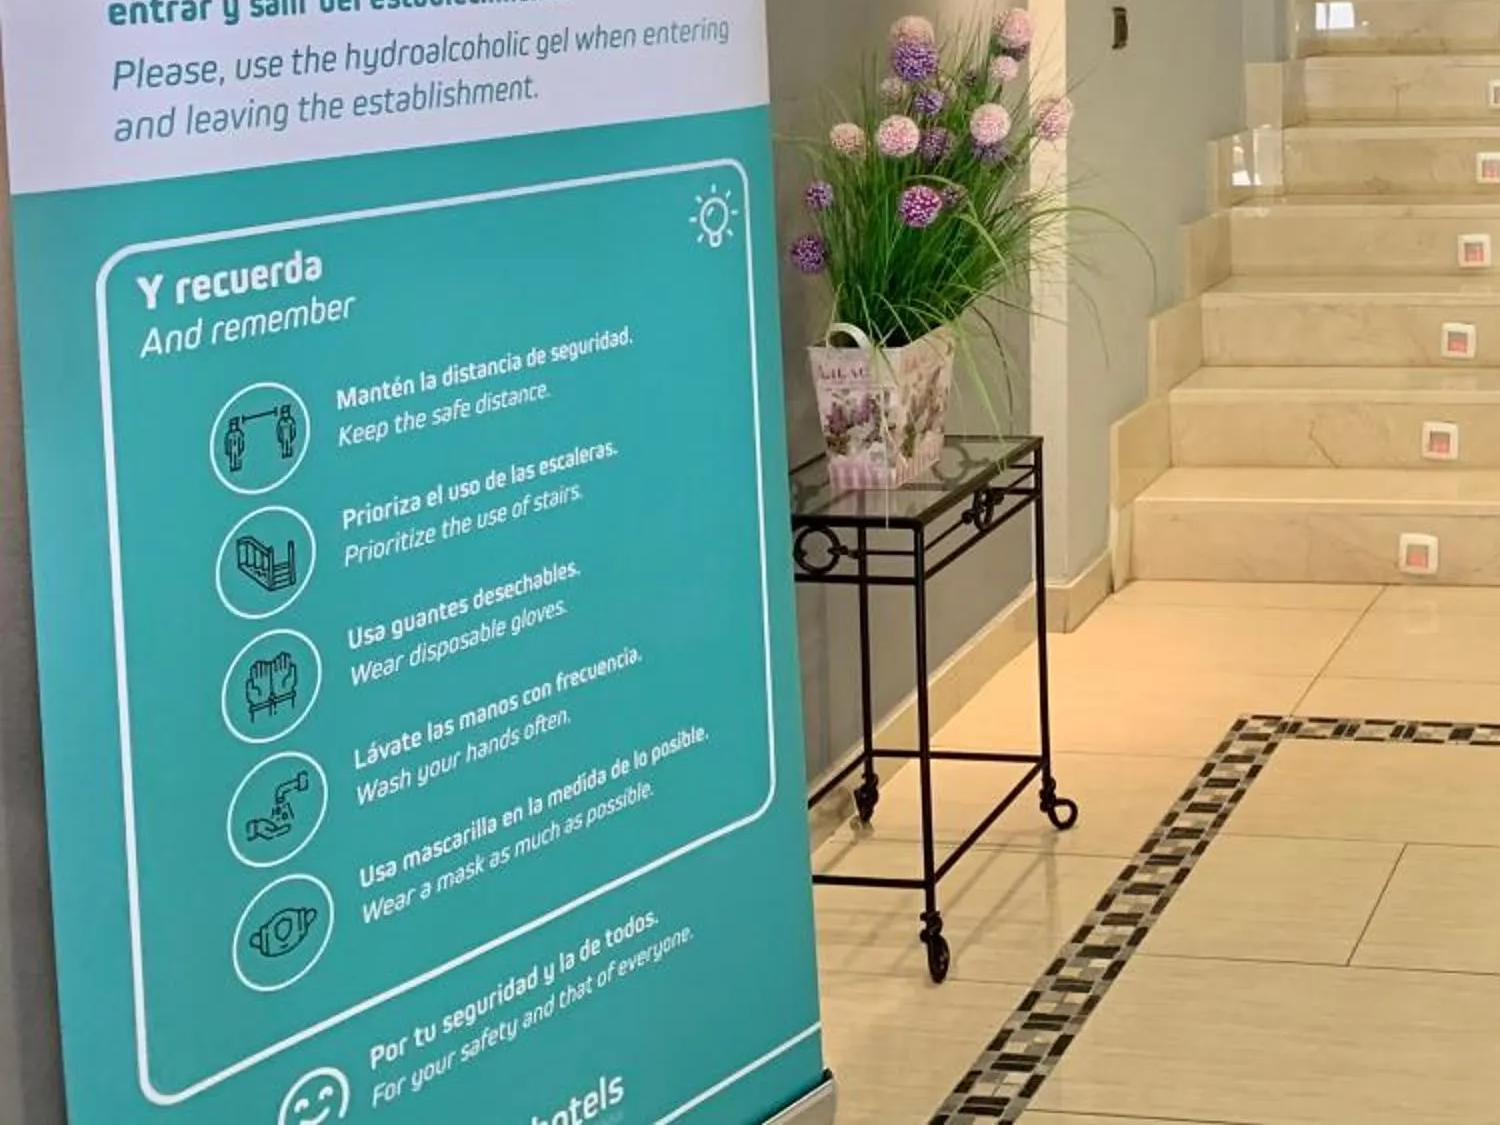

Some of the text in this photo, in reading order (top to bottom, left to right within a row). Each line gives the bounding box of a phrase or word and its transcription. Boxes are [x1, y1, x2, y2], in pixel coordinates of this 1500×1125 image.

[113, 17, 728, 90] Please, use the hydroalcoholic gel when entering
[115, 76, 538, 142] and leaving the establishment.
[136, 250, 322, 310] Y recuerda
[140, 295, 356, 358] And remember
[336, 326, 633, 410] Mantén la distancia de seguridad.
[339, 384, 550, 447] Keep the safe distance.
[342, 442, 618, 530] Prioriza el uso de las escaleras.
[345, 484, 582, 567] Prioritize the use of stairs.
[348, 561, 580, 649] Usa guantes desechables.
[351, 600, 568, 686] Wear disposable gloves.
[354, 647, 642, 769] Lávate las manos con frecuencia.
[357, 710, 571, 805] Wash your hands often.
[360, 726, 708, 888] Usa mascarilla en la medida de lo posible.
[363, 782, 653, 923] Wear a mask as much as possible.
[370, 911, 658, 1070] Por tu seguridad y la de todos.
[372, 927, 693, 1108] For your safety and that of everyone.
